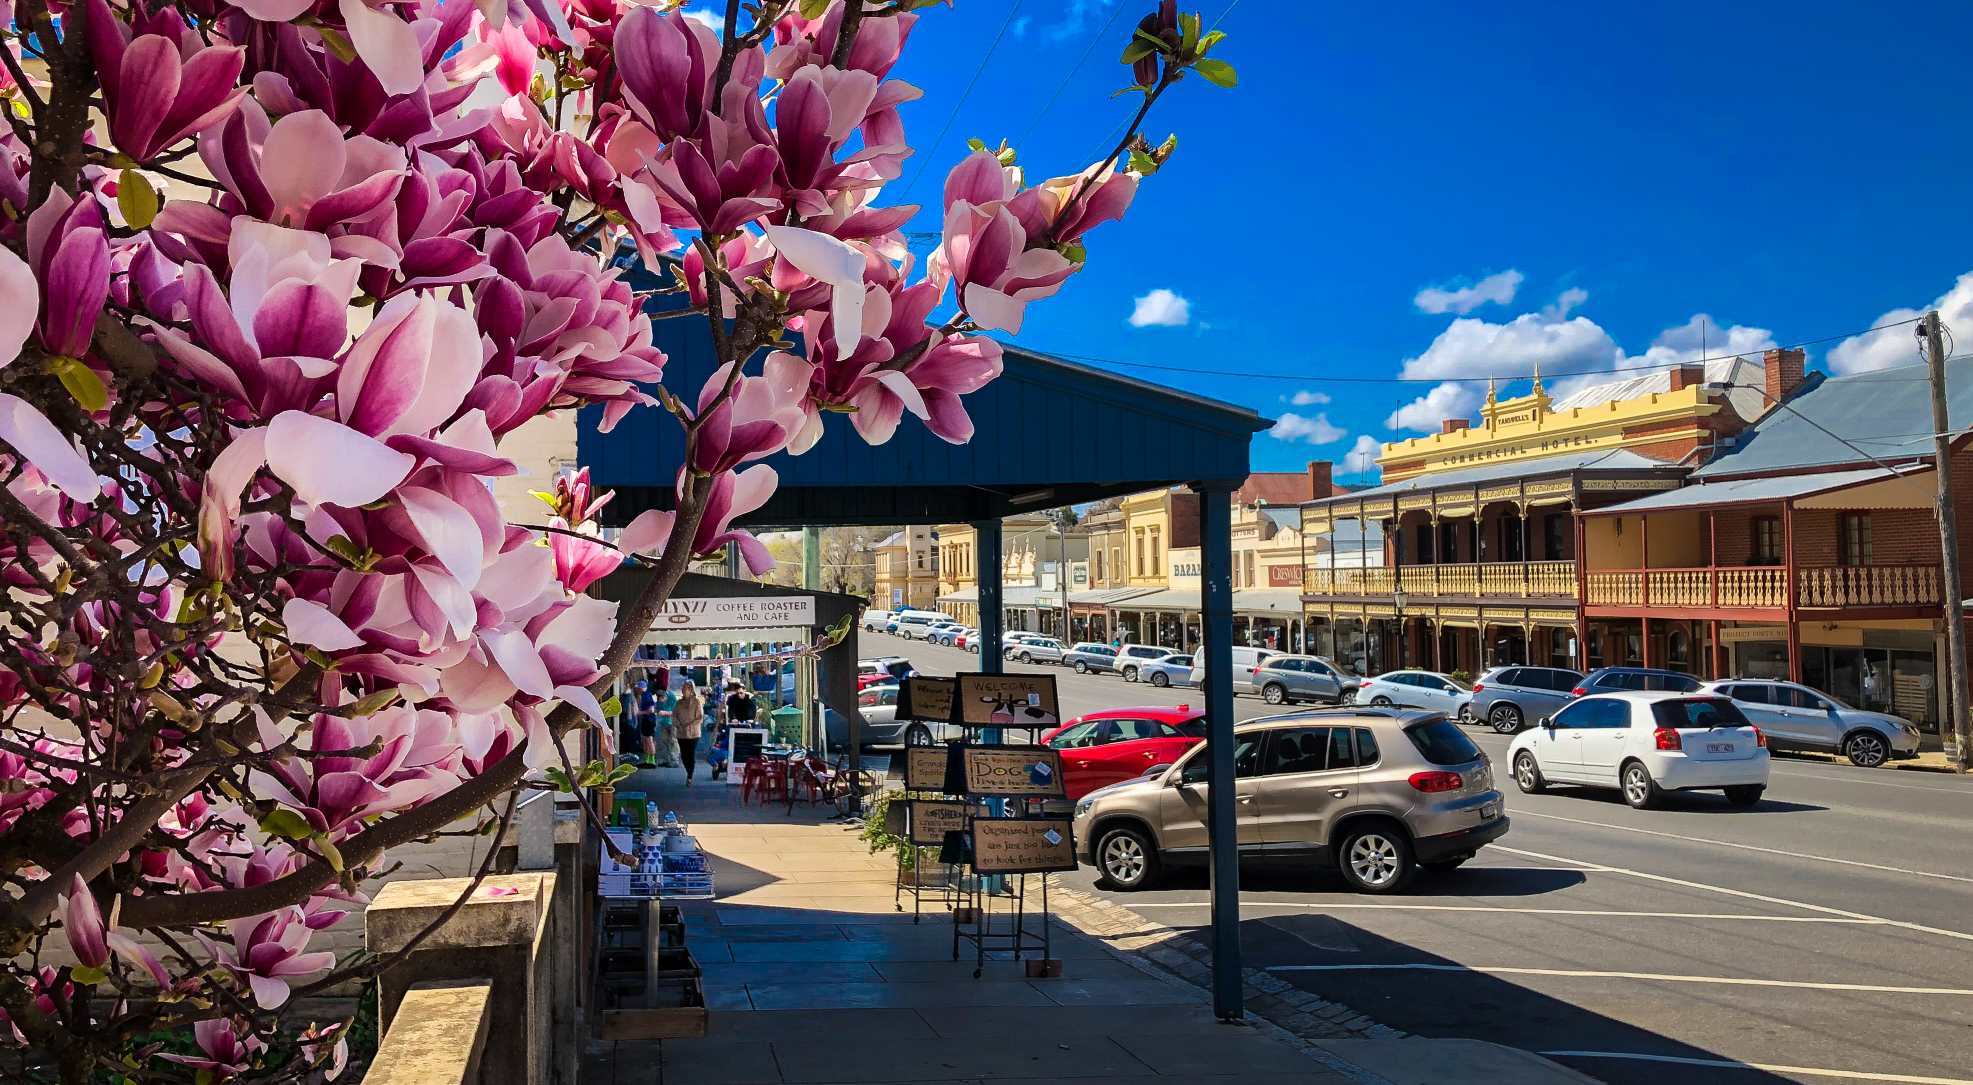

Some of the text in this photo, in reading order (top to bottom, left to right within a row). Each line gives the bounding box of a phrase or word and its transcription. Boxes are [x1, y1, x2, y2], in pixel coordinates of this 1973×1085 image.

[1442, 445, 1527, 465] COMMERCIAL
[716, 603, 754, 612] COFFEE
[760, 601, 807, 611] ROASTER
[736, 612, 789, 621] AND CAFE
[975, 681, 1036, 692] WELCOME
